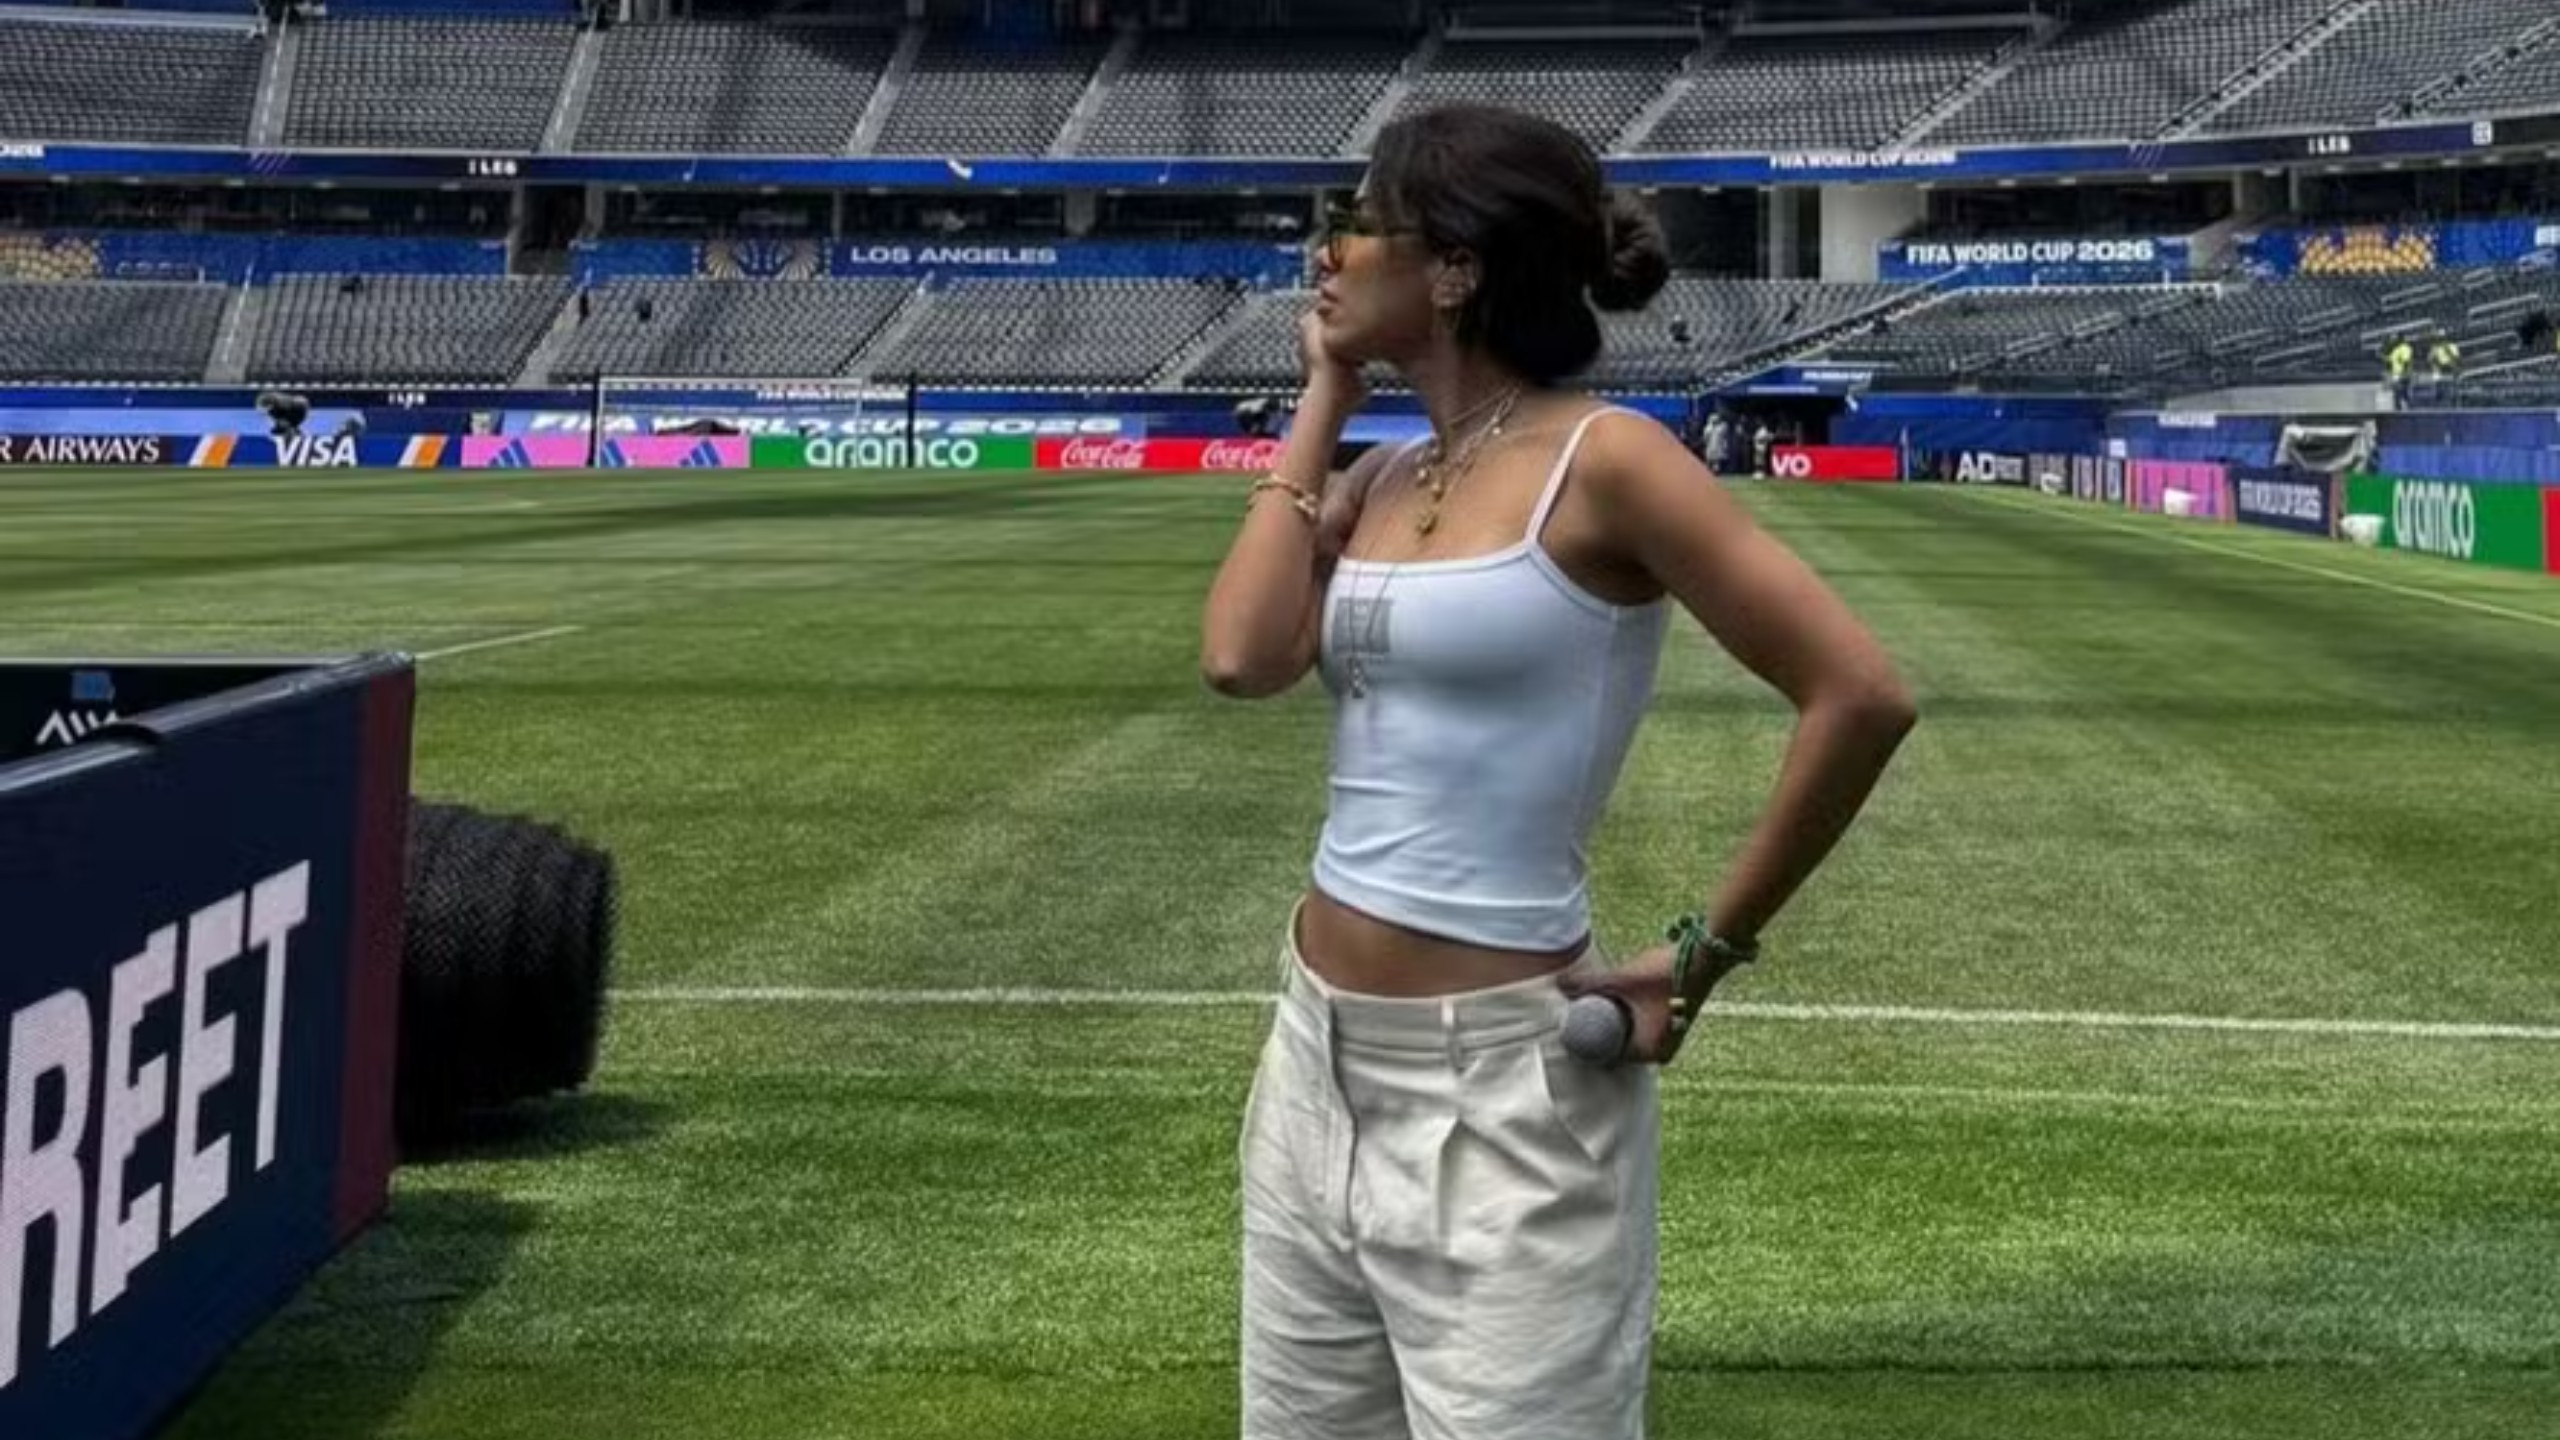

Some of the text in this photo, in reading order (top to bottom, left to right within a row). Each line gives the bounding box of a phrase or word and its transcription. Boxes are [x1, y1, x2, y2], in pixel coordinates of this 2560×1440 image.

[851, 247, 1057, 264] LOS ANGELES
[1907, 239, 2155, 265] FIFA WORLD CUP 2026
[947, 417, 1122, 434] 2026
[24, 437, 160, 463] AIRWAYS
[274, 436, 358, 468] VISA
[805, 437, 979, 468] aramco
[1771, 453, 1812, 477] VO
[2392, 479, 2475, 558] aramco
[0, 859, 310, 1388] REET
